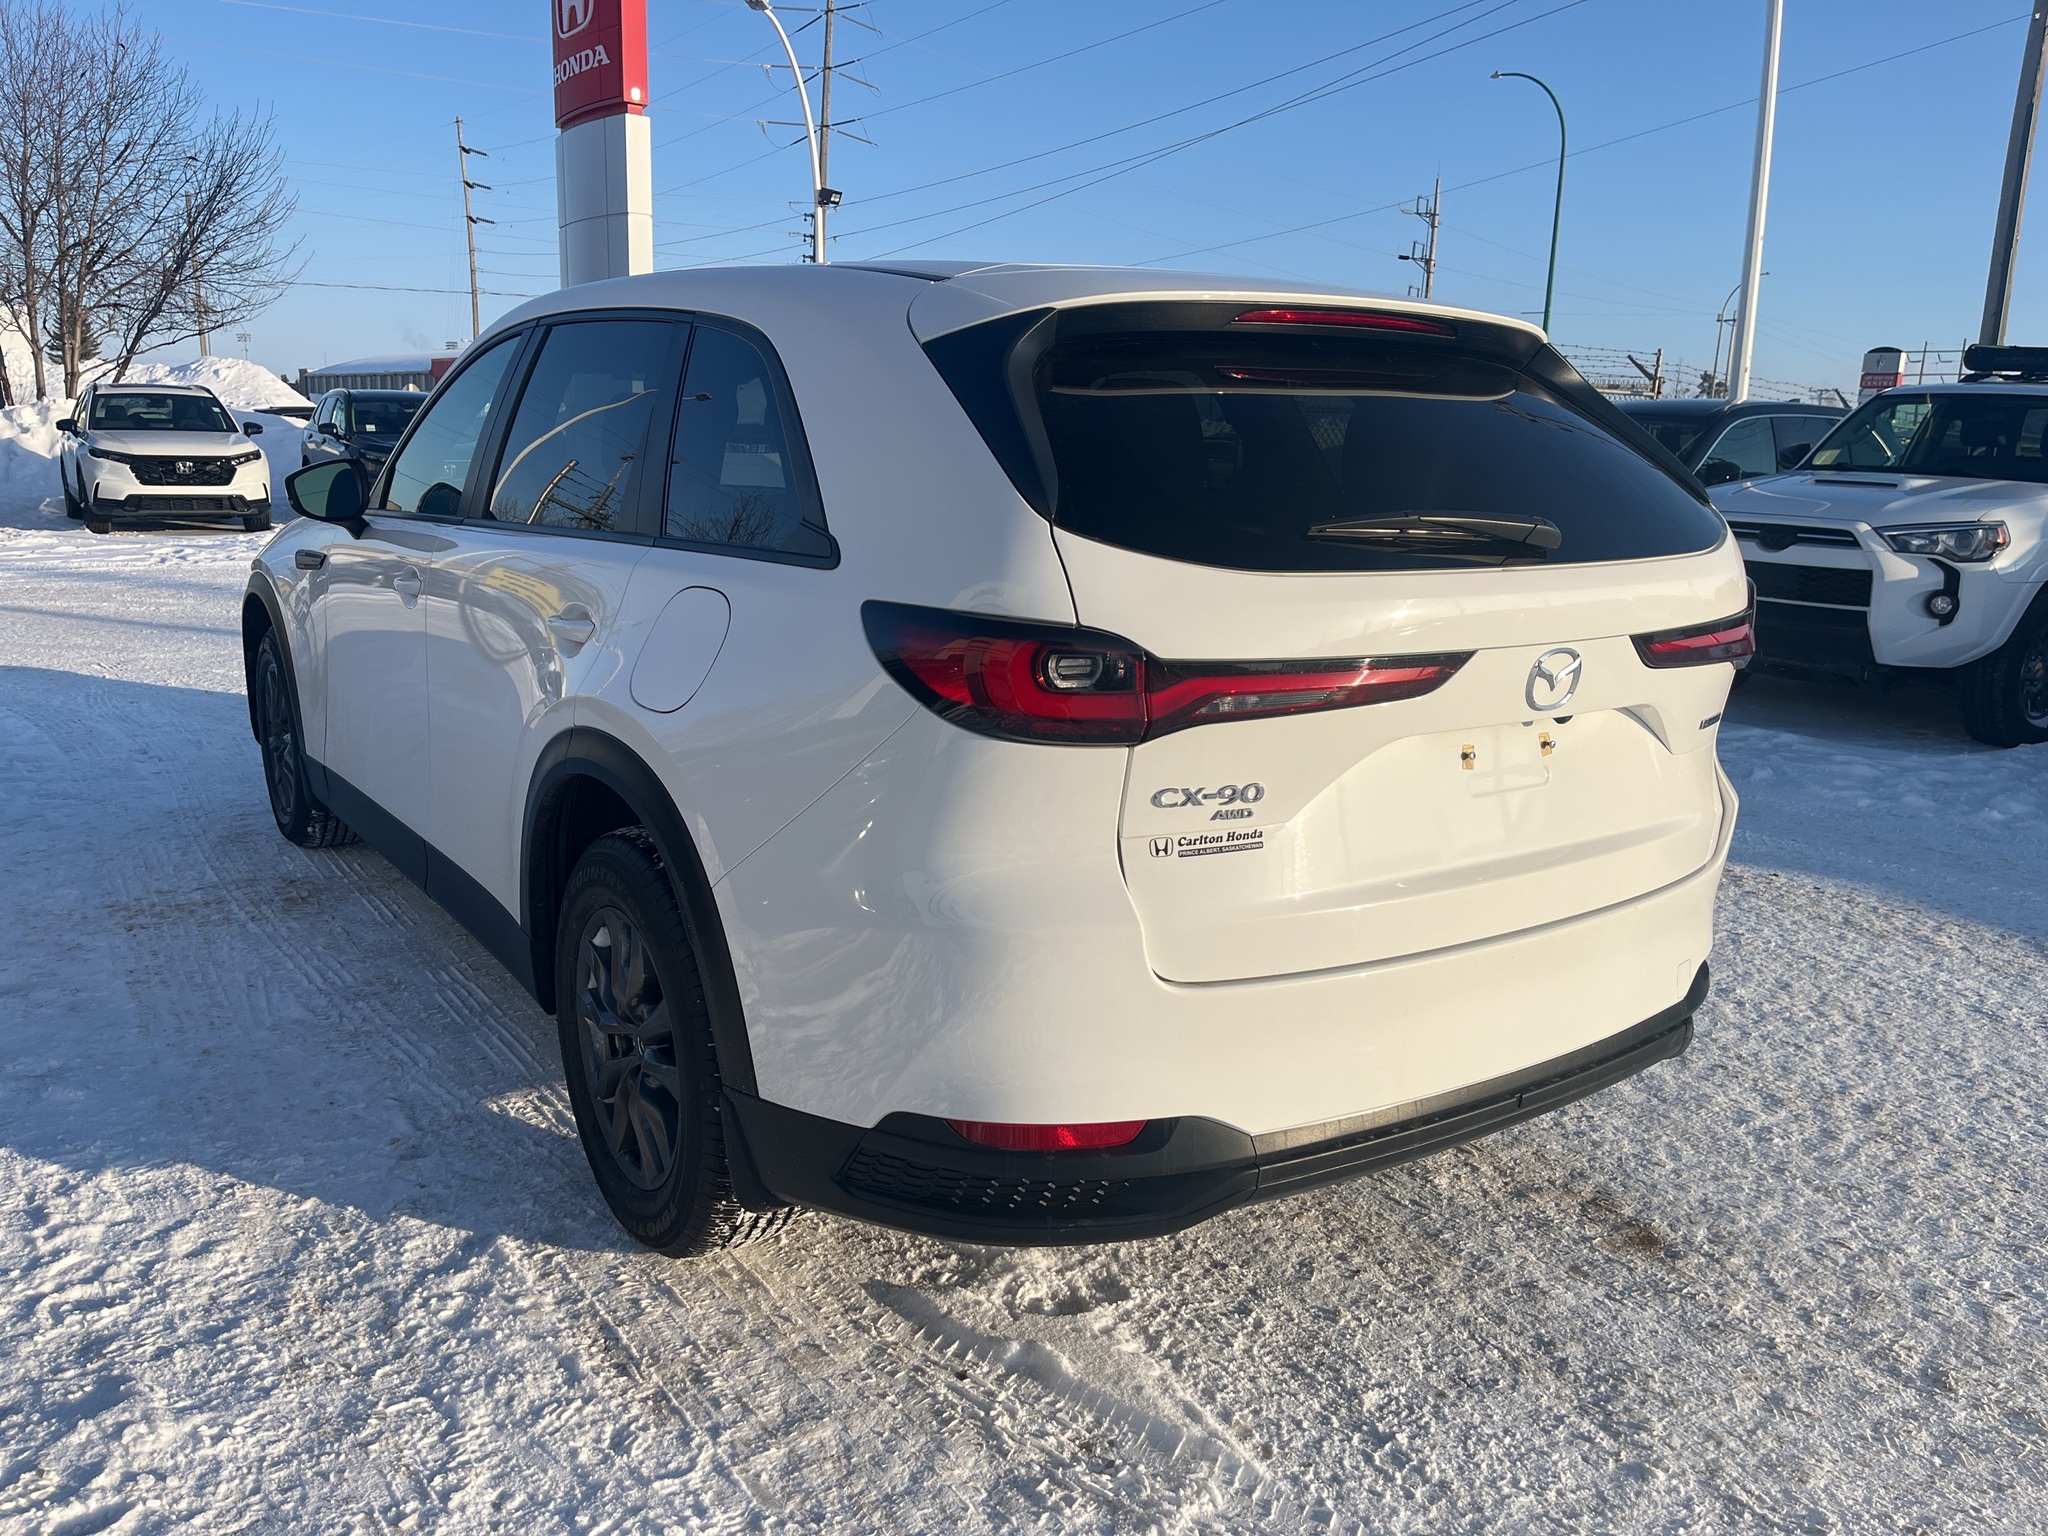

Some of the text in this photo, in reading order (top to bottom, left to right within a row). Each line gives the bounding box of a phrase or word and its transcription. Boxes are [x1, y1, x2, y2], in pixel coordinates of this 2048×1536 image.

[554, 44, 610, 87] HONDA
[1150, 782, 1265, 808] CX-90
[1210, 808, 1254, 821] AWD
[1178, 829, 1263, 846] Carlton Honda
[1222, 843, 1263, 852] SASKATCHEWAN
[570, 865, 626, 896] COUNTRY
[647, 1199, 677, 1237] TOYO
